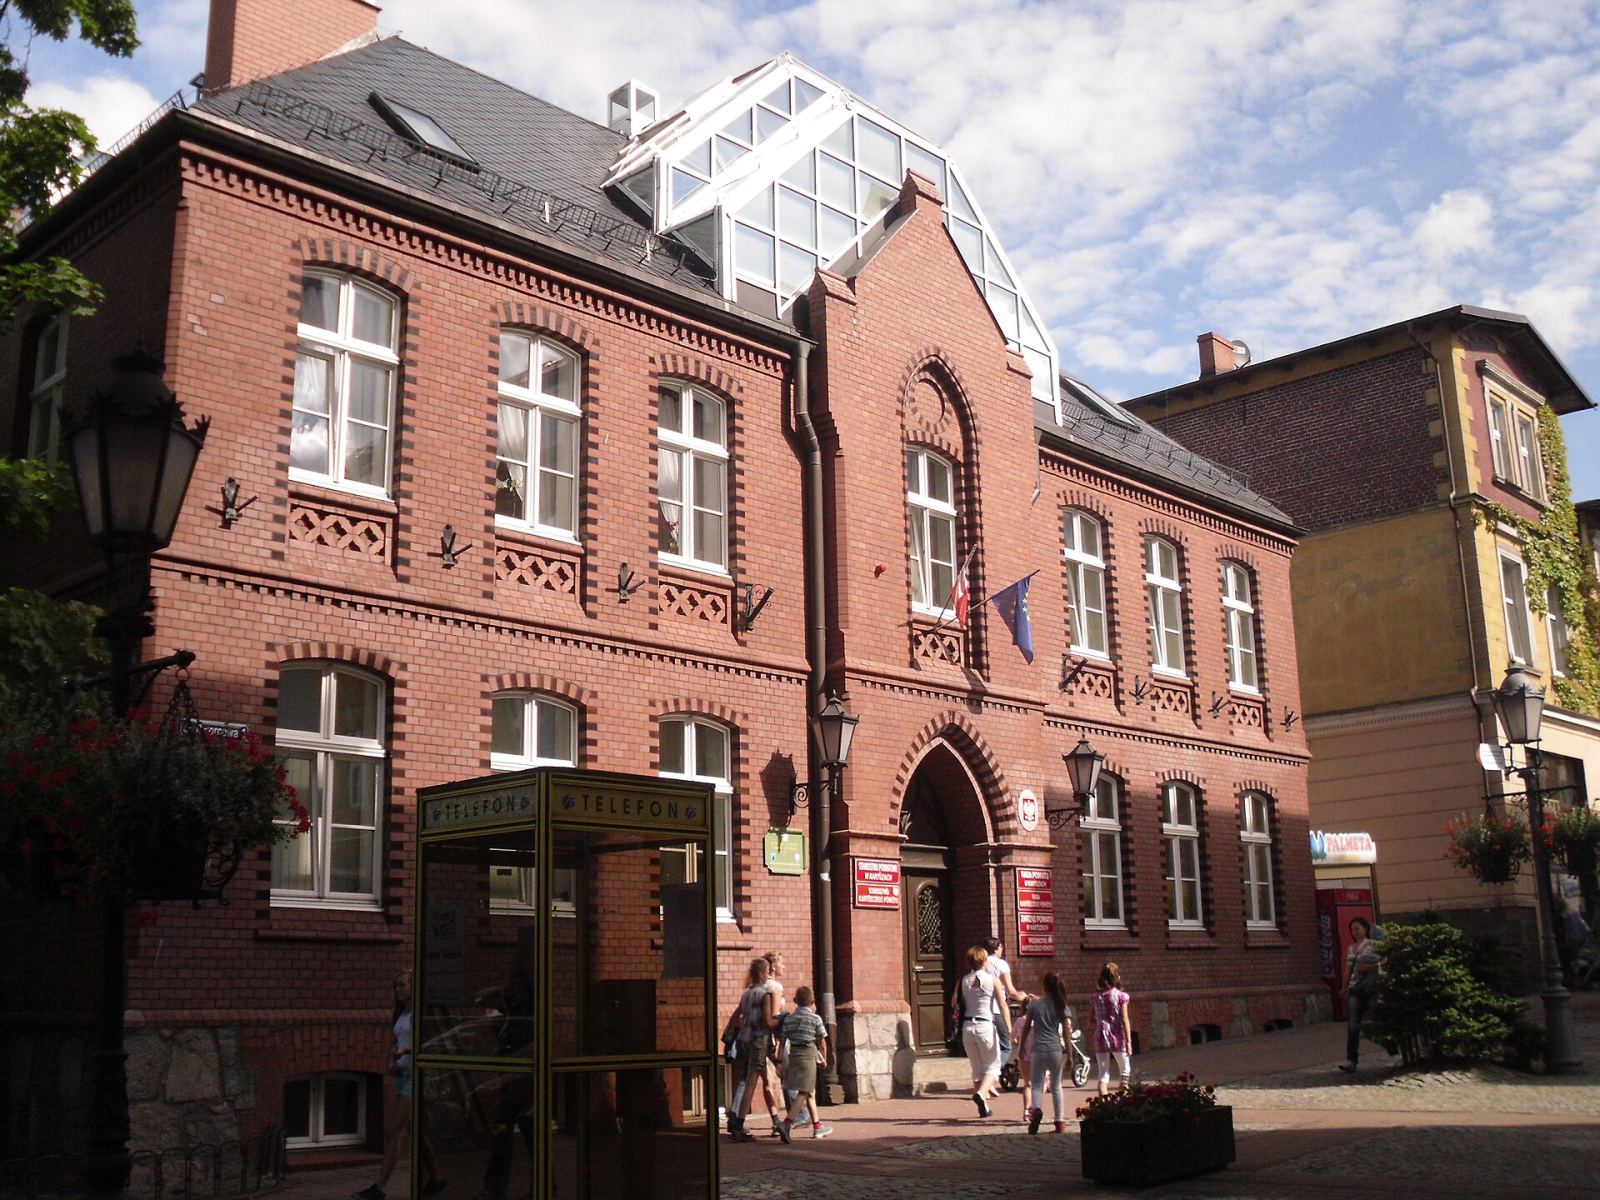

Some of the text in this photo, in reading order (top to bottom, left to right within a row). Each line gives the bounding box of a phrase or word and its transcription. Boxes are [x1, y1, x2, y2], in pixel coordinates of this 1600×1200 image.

[445, 795, 516, 820] TELEFON
[582, 794, 678, 818] TELEFON
[1326, 836, 1372, 851] PALMETA
